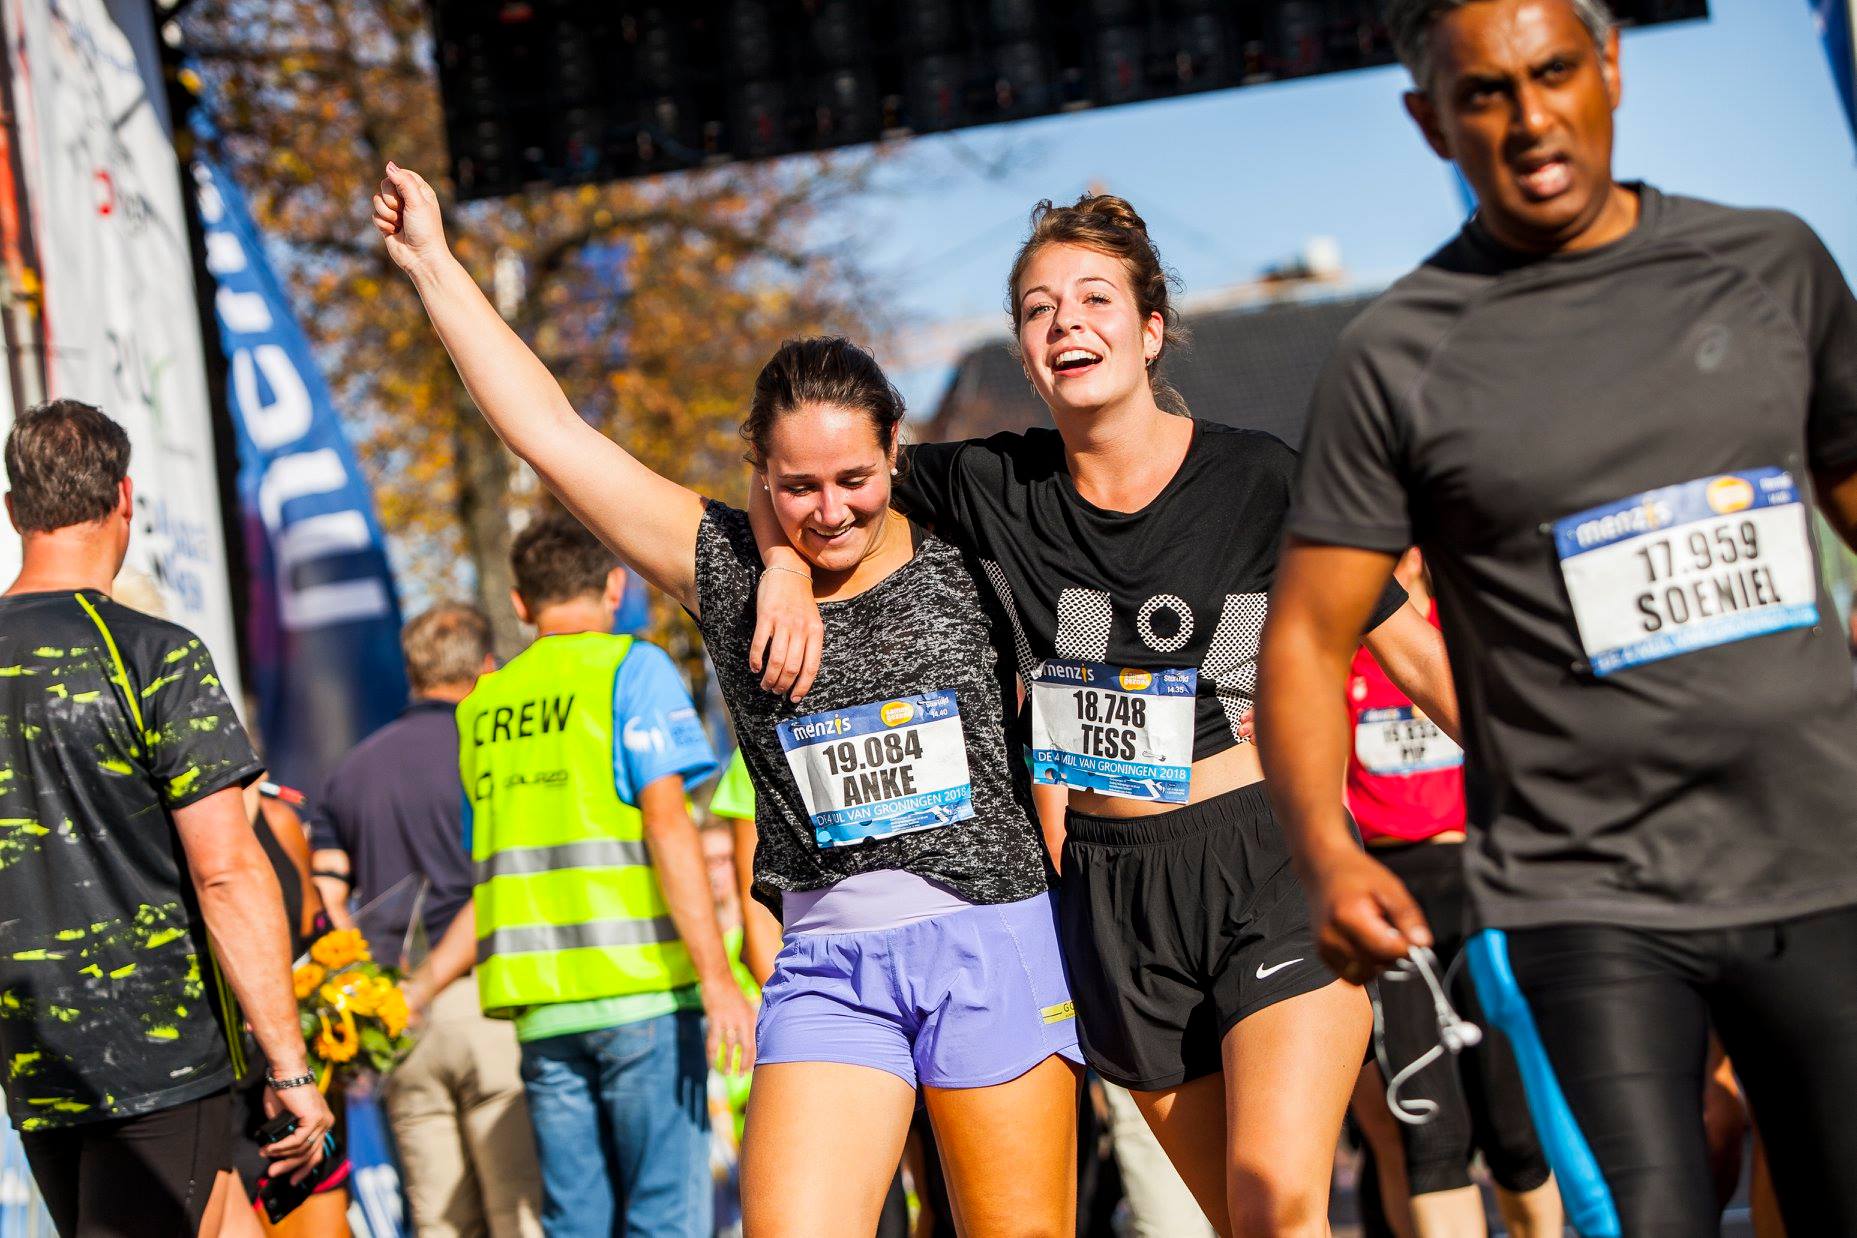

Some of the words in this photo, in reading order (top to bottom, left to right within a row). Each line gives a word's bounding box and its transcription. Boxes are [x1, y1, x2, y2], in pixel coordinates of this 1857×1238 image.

[1636, 519, 1760, 583] 17.959
[1637, 565, 1783, 633] SOENIEL
[1043, 663, 1095, 683] menzis
[473, 694, 575, 747] CREW
[793, 713, 852, 741] menzis
[1072, 689, 1147, 729] 18.748
[822, 729, 924, 776] 19.084
[1081, 723, 1137, 762] TESS
[842, 764, 918, 807] ANKE
[1038, 751, 1053, 763] DE
[1054, 754, 1060, 762] 4
[1079, 758, 1096, 770] VAN
[1097, 761, 1157, 778] GRONINGEN
[1159, 768, 1187, 780] 2018
[847, 807, 871, 821] VAN
[873, 793, 942, 815] GRONINGEN
[944, 786, 967, 801] 2018
